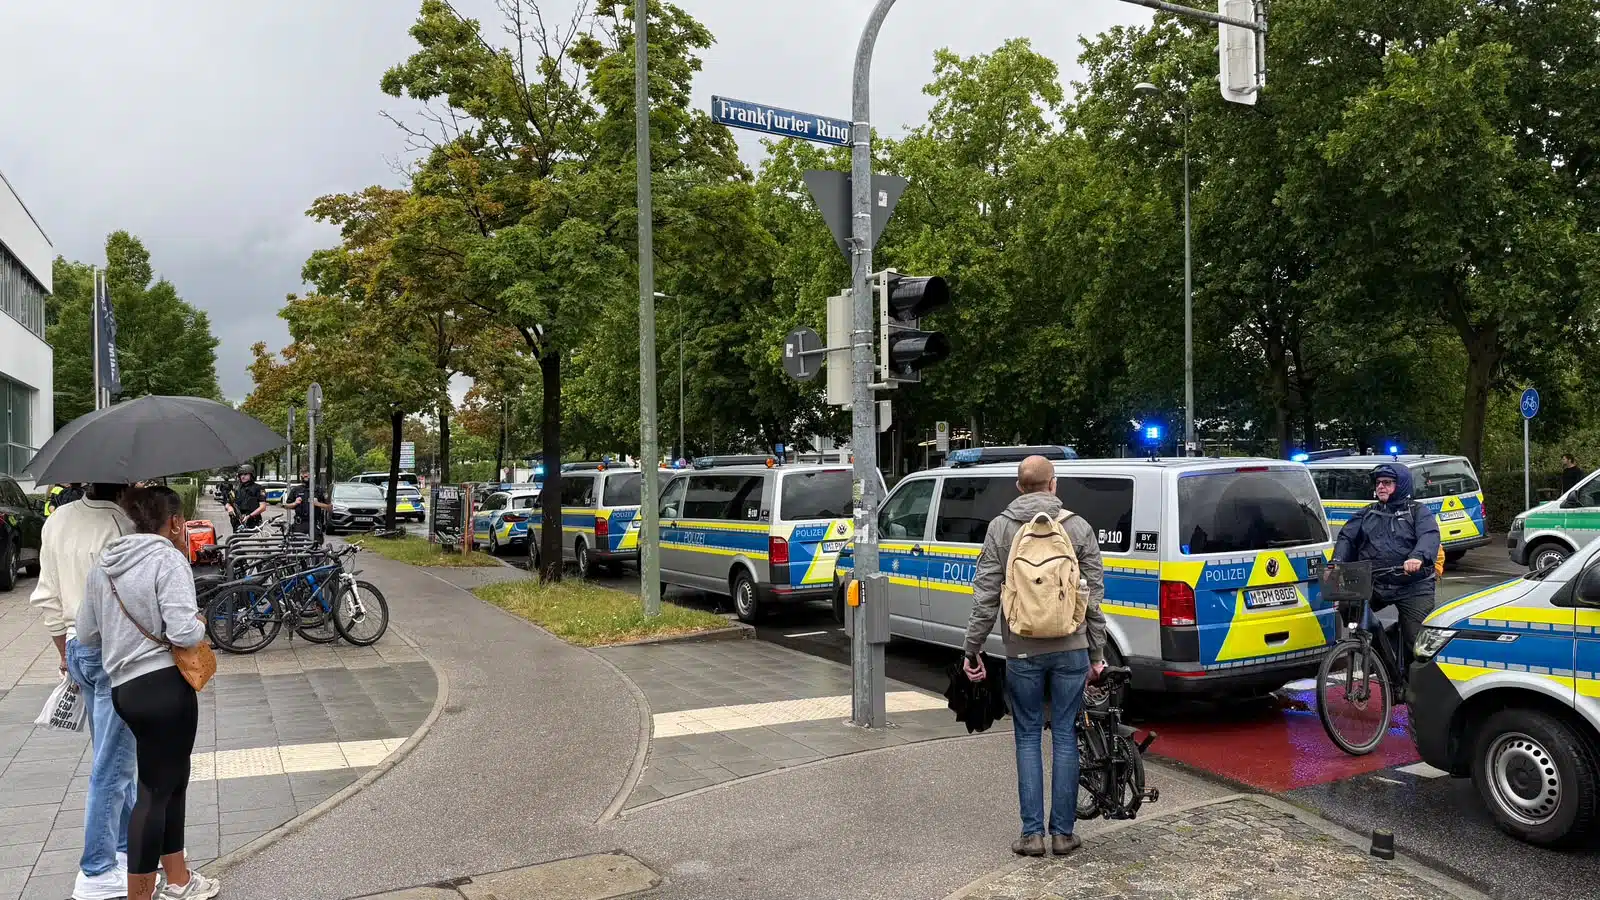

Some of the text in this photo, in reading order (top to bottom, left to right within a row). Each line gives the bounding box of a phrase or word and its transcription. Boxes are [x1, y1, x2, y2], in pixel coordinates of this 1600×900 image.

[720, 100, 849, 144] Frankfurter Ring
[683, 532, 706, 545] POLIZEI
[795, 529, 824, 537] POLIZEI
[1107, 531, 1122, 543] 110
[1205, 568, 1246, 582] POLIZEI
[1250, 587, 1295, 605] M PM 8805
[54, 708, 73, 720] SHOP
